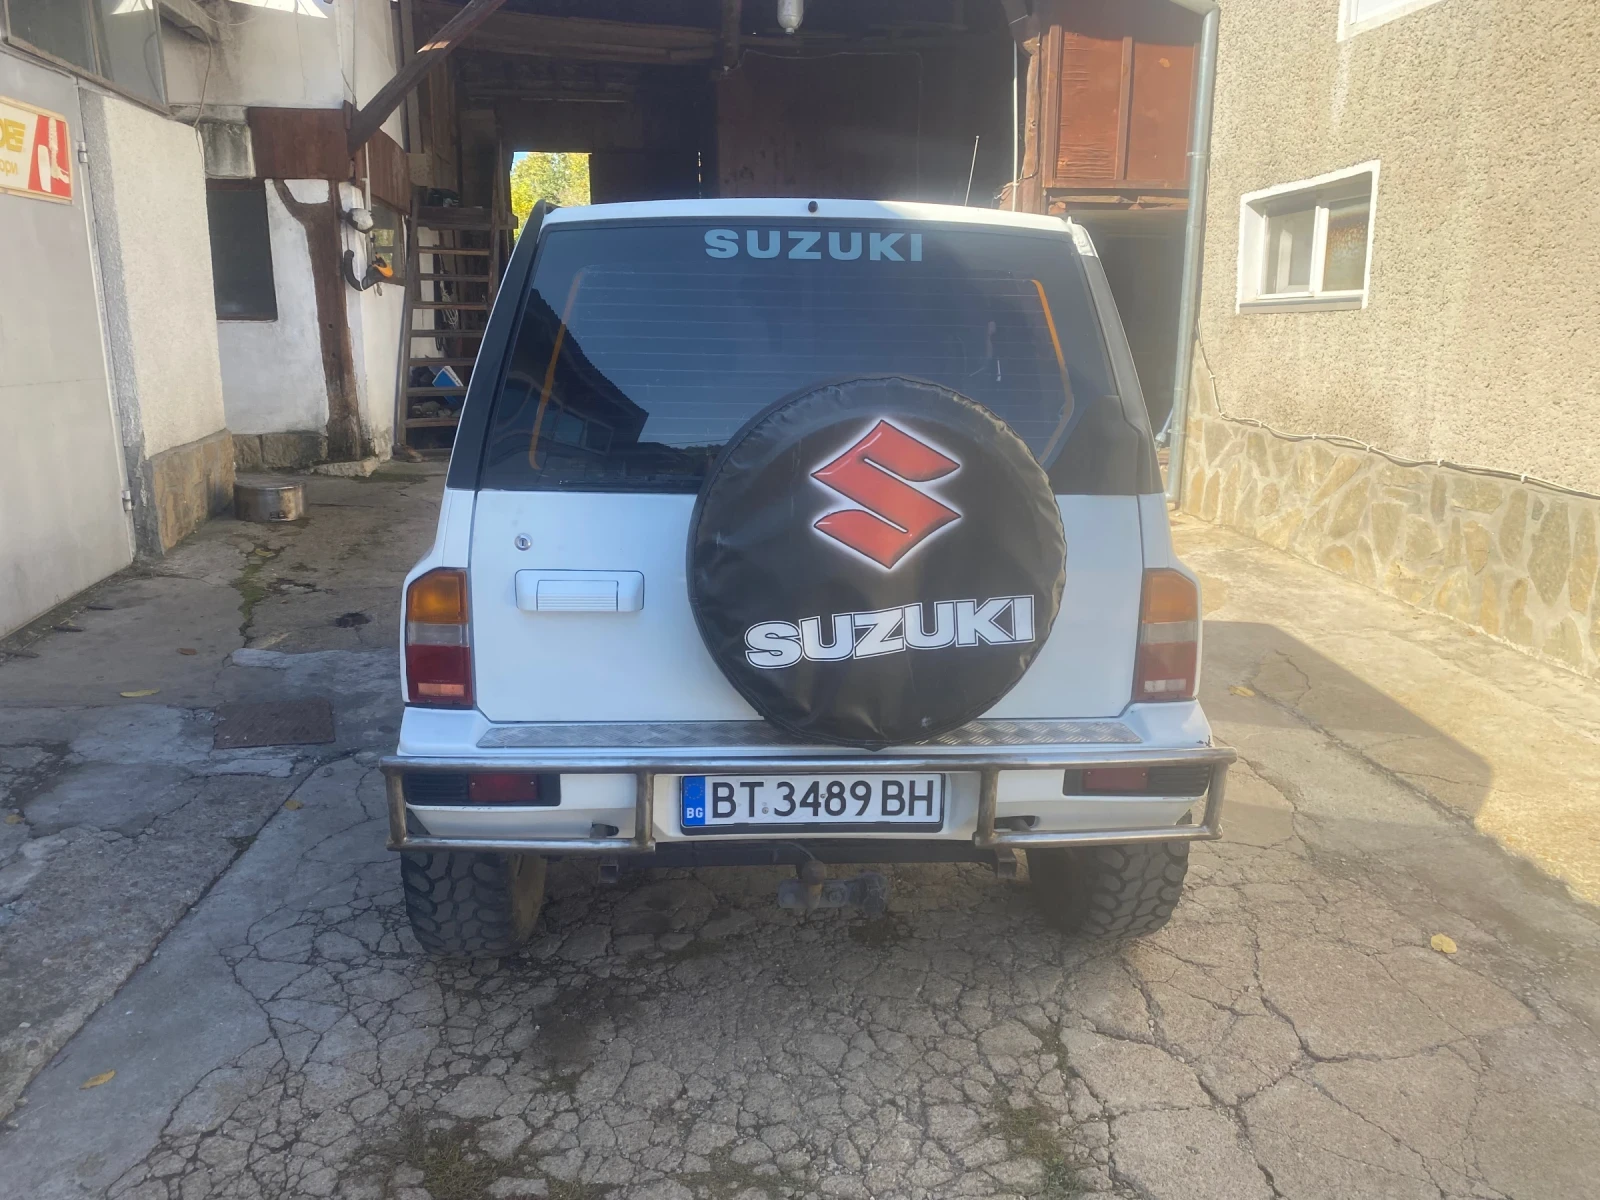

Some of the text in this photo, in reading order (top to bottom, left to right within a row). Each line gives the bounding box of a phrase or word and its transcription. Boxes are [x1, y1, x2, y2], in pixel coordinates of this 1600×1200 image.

[703, 228, 923, 262] SUZUKI
[744, 594, 1036, 669] SUZUKI
[686, 807, 704, 819] BG
[711, 780, 934, 819] BT 3489 BH
